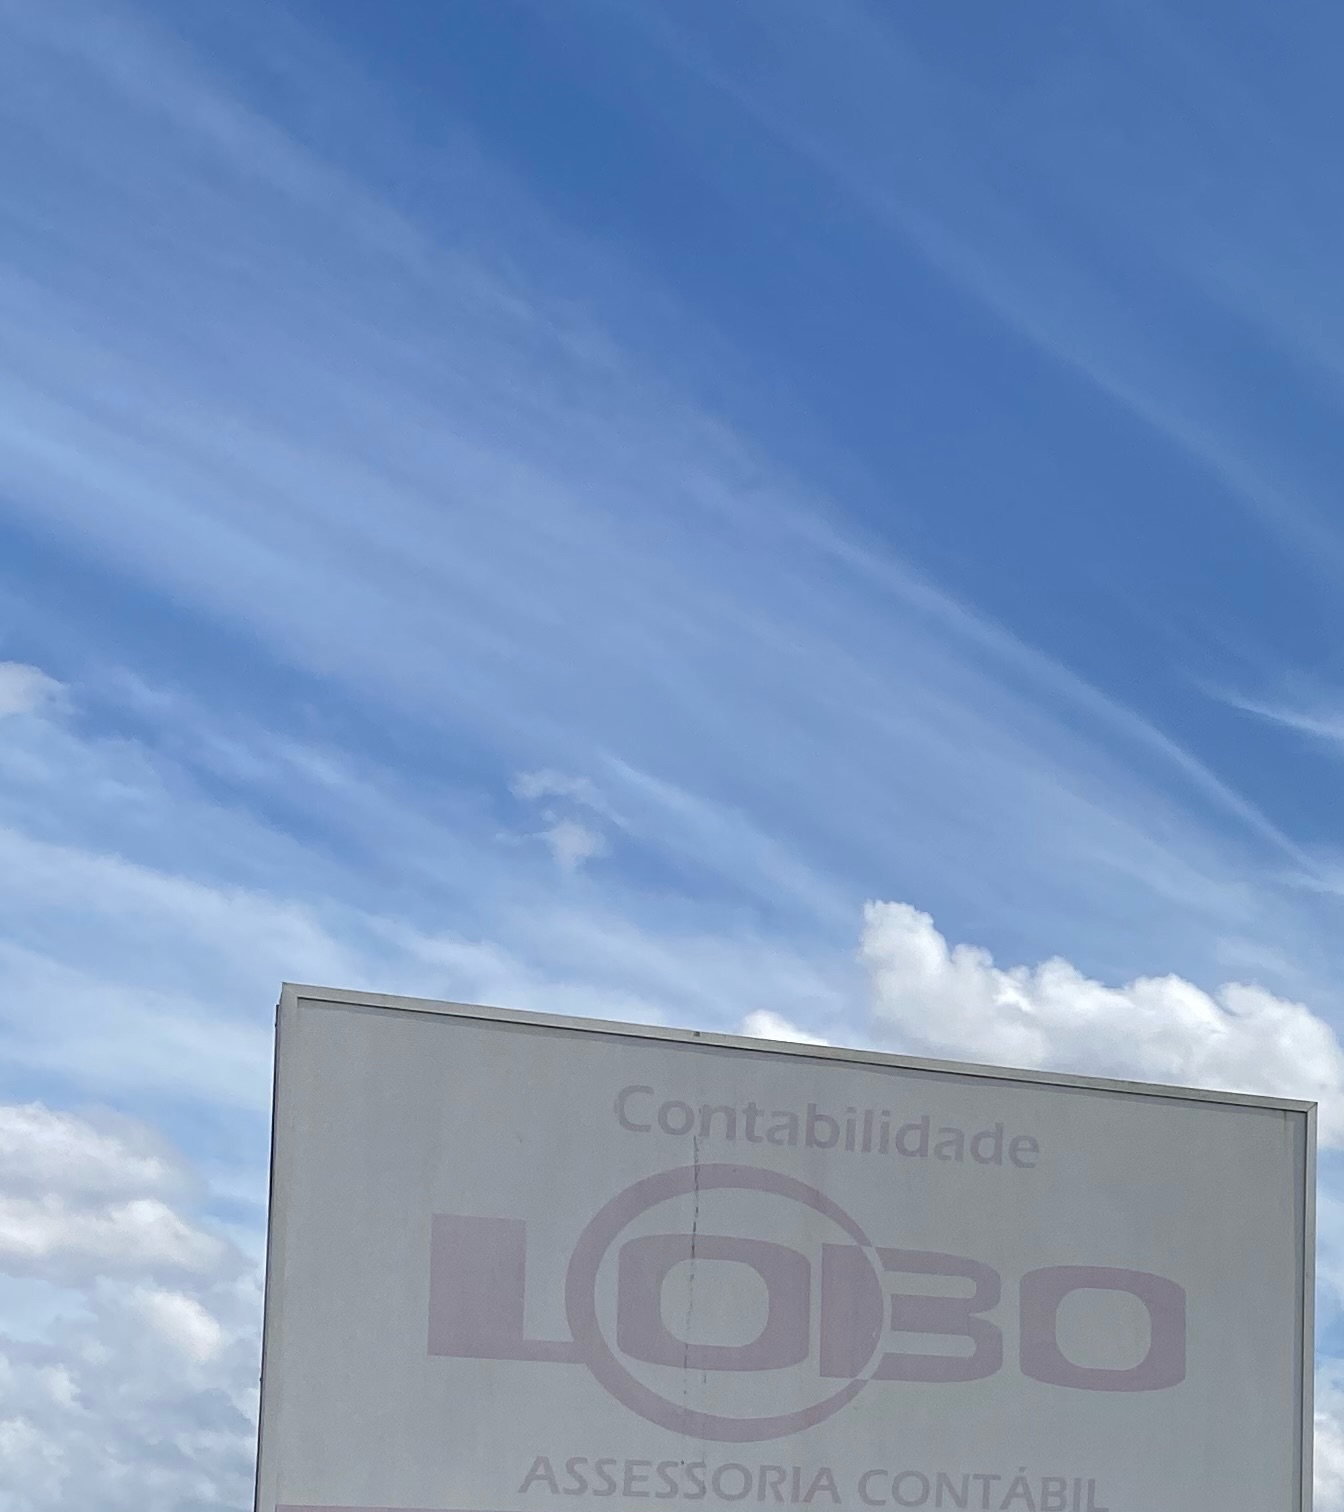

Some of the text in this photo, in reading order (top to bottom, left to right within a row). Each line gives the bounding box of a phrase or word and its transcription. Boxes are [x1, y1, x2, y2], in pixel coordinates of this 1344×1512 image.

[612, 1082, 1041, 1169] Contabilidade
[427, 1212, 1187, 1392] LOBO
[517, 1455, 842, 1507] ASSESSORIA
